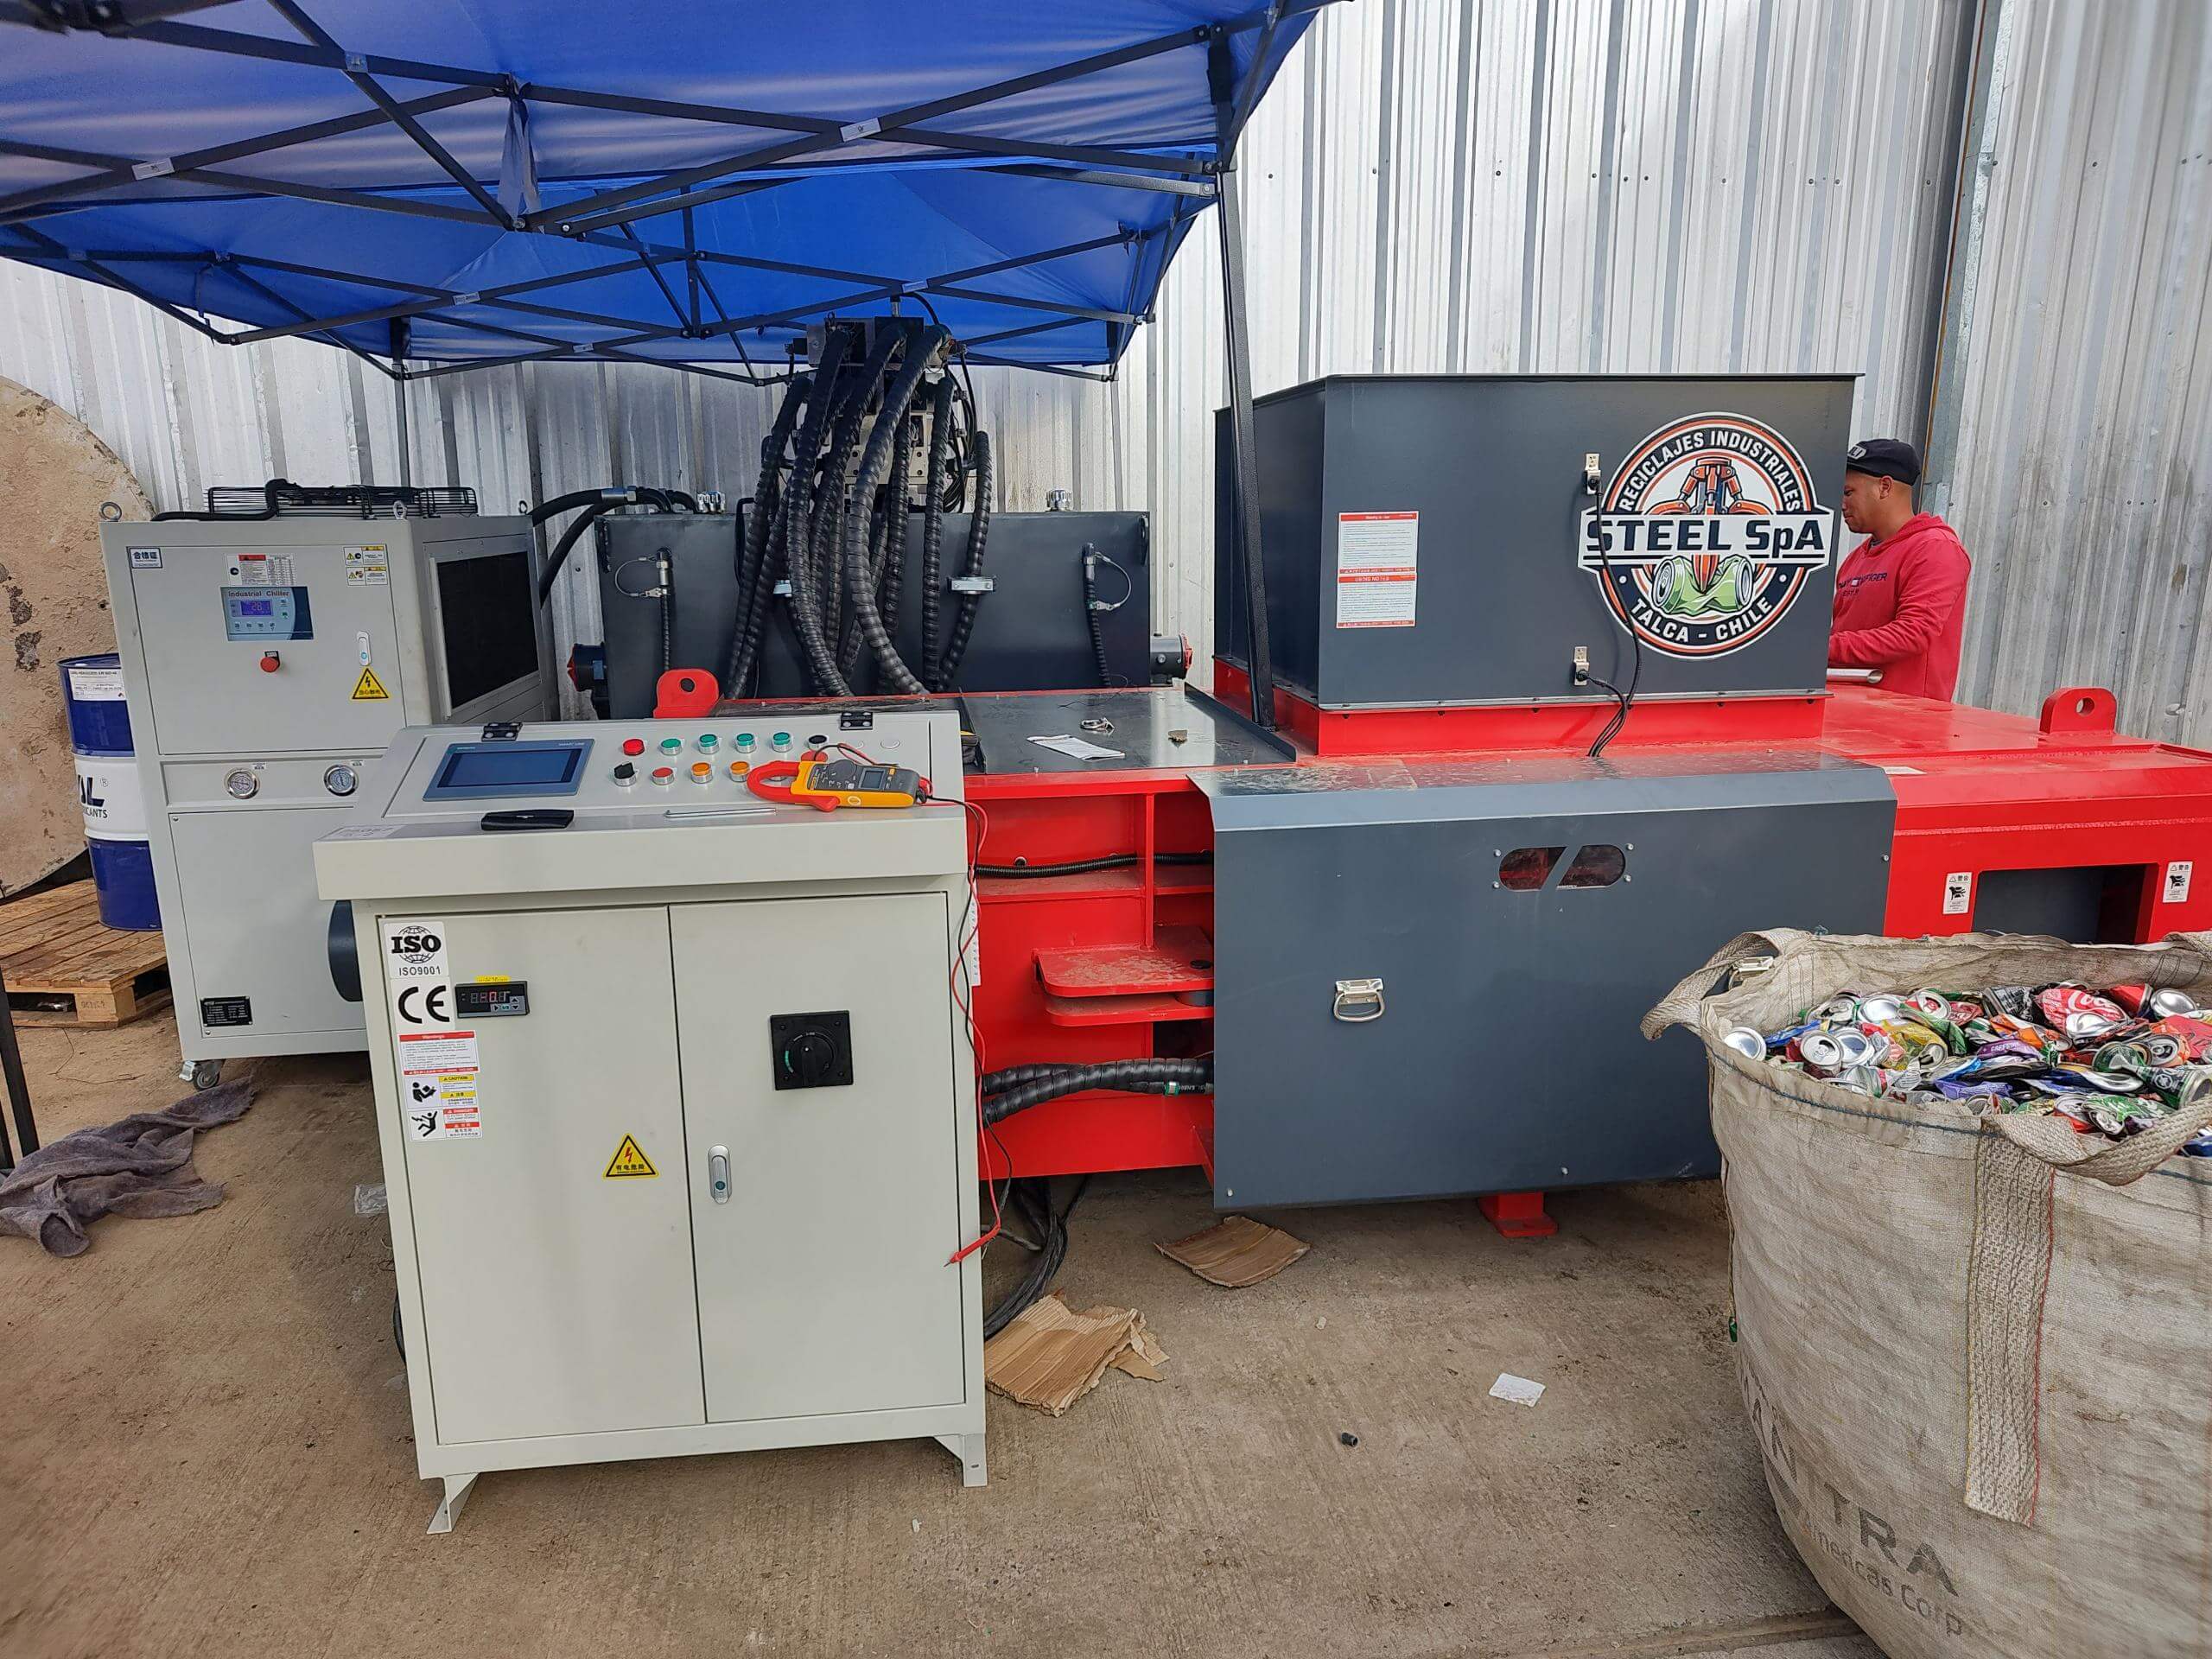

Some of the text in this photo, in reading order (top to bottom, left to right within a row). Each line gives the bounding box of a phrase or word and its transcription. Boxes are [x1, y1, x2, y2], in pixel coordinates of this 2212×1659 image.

[1618, 430, 1801, 512] RECICLAJES INDUSTRIALES
[1586, 519, 1825, 558] STEEL SpA
[1630, 597, 1689, 643] TALCA
[1715, 596, 1773, 641] CHILE
[391, 934, 442, 954] ISO
[398, 965, 442, 976] ISO9001
[397, 984, 450, 1024] CE
